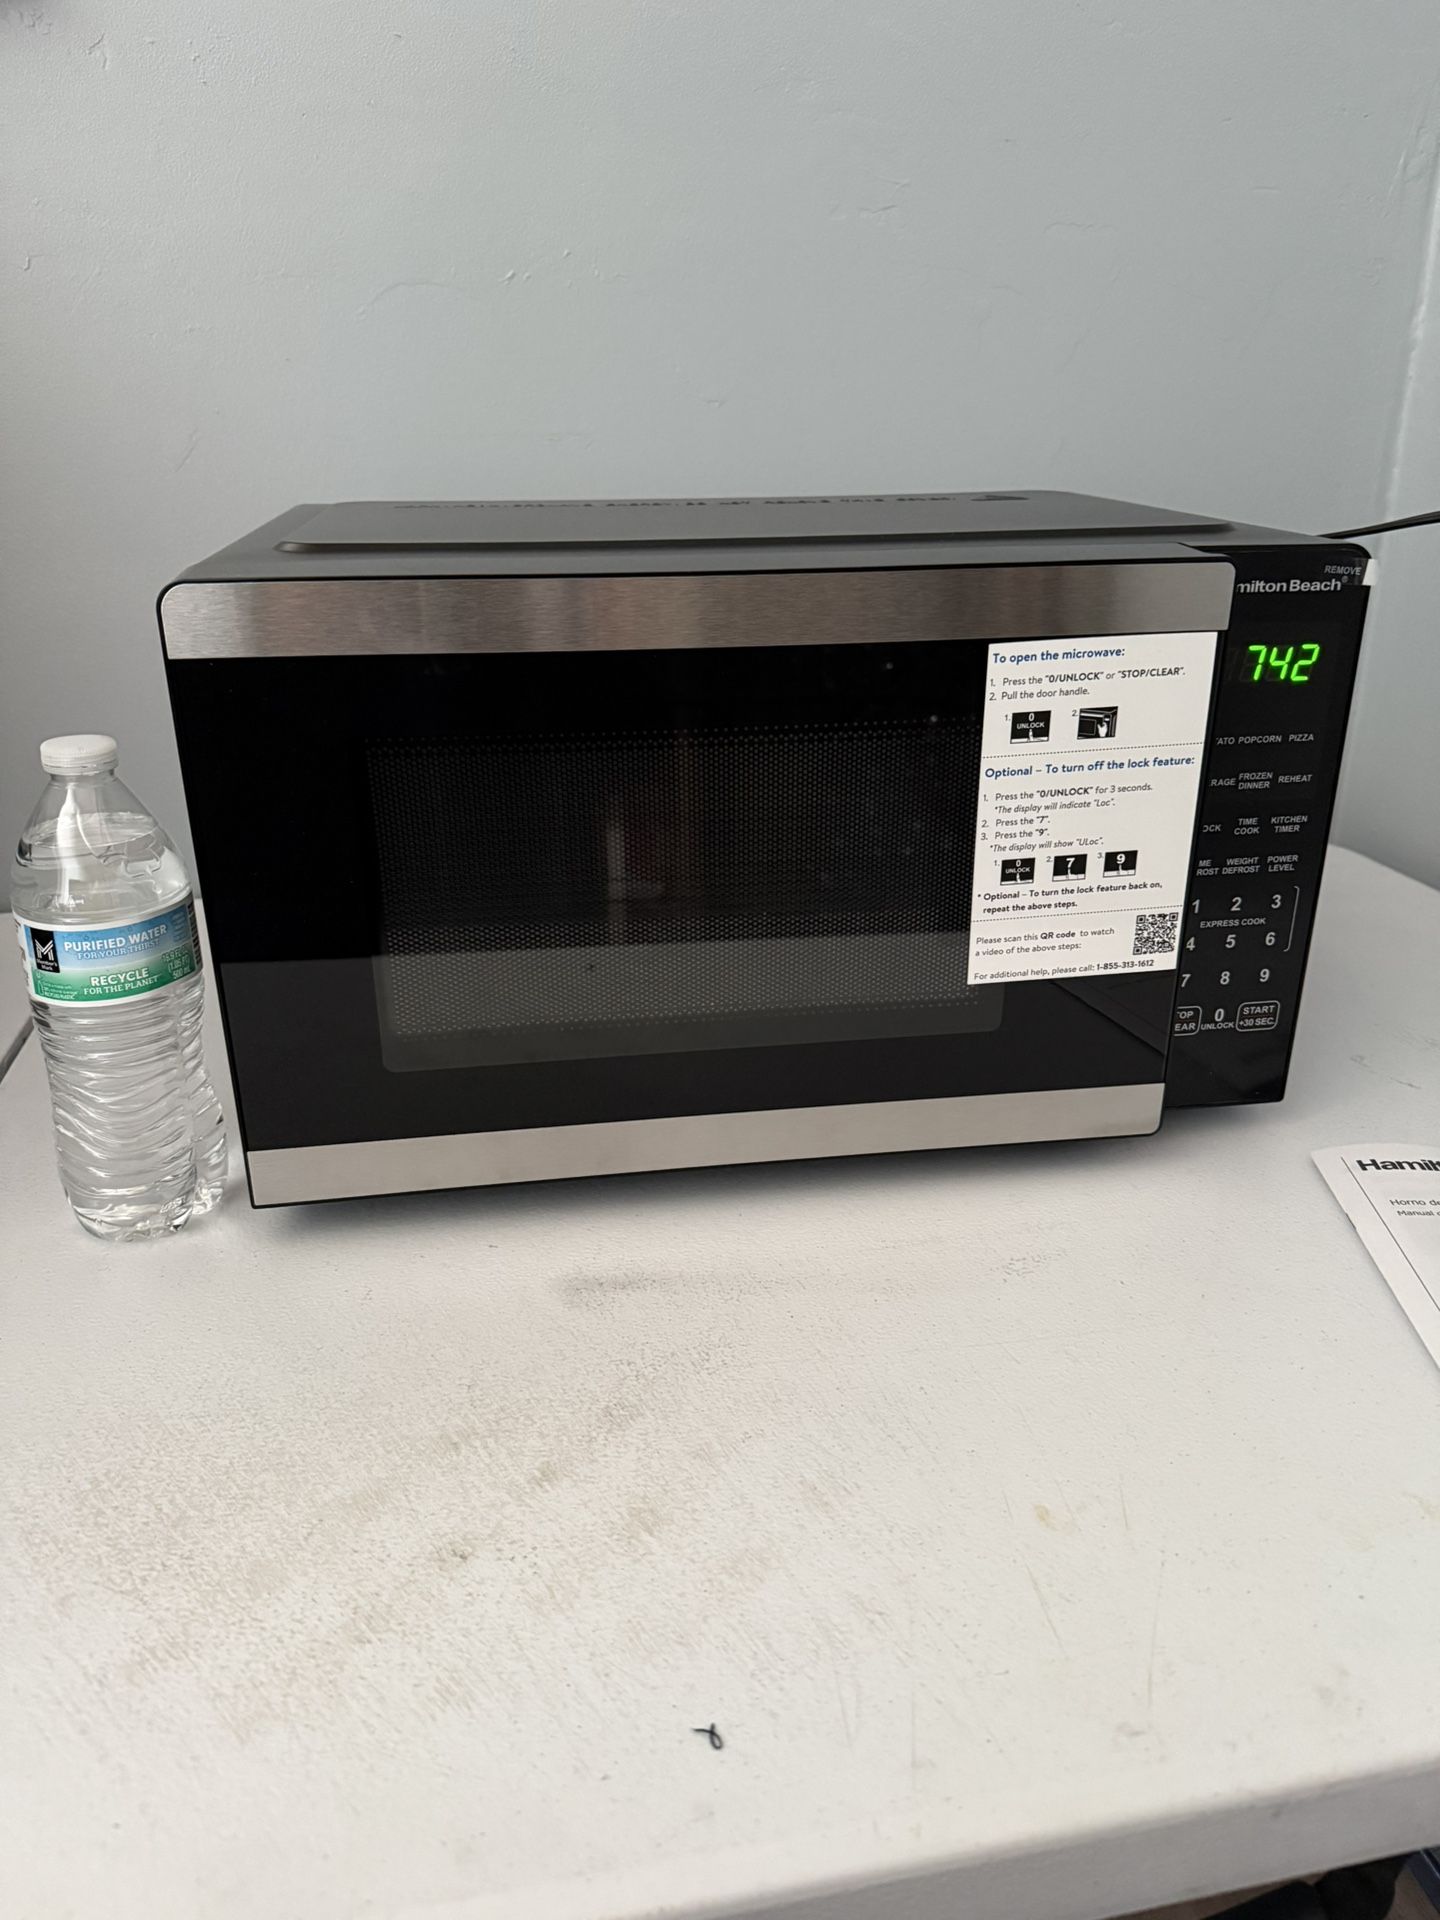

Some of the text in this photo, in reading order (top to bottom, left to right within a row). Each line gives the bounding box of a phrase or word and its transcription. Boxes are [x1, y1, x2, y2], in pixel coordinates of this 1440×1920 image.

[1324, 565, 1362, 575] REMOVE
[993, 648, 1125, 665] To open the microwave:
[990, 678, 996, 687] 1.
[1002, 677, 1026, 686] Press
[1028, 676, 1042, 685] the
[989, 687, 1090, 701] 2. Pull the door handle.
[1028, 713, 1034, 721] 0
[1216, 737, 1235, 745] ATO
[1238, 735, 1283, 744] POPCORN
[1288, 734, 1315, 742] PIZZA
[985, 765, 1033, 780] Optional
[1046, 764, 1058, 774] To
[1062, 763, 1084, 773] turn
[1087, 760, 1105, 771] off
[1107, 760, 1125, 770] the
[1127, 758, 1150, 769] lock
[1152, 757, 1195, 767] feature:
[1239, 772, 1273, 780] FROZEN
[1278, 774, 1312, 783] REHEAT
[1238, 781, 1270, 790] DINNER
[995, 792, 1018, 801] Press
[1020, 791, 1034, 800] the
[1095, 786, 1108, 794] for
[1110, 785, 1116, 793] 3
[1117, 783, 1153, 793] seconds.
[1014, 803, 1042, 814] display
[1044, 802, 1058, 810] will
[1060, 800, 1091, 810] indicate
[981, 820, 989, 828] 2.
[995, 819, 1018, 827] Press
[1020, 817, 1034, 826] the
[1271, 815, 1308, 824] KITCHEN
[1234, 827, 1260, 835] COOK
[1274, 825, 1300, 833] TIMER
[980, 832, 989, 841] 3.
[994, 831, 1017, 840] Press
[1019, 830, 1033, 838] the
[1008, 842, 1037, 853] display
[1038, 840, 1052, 849] will
[1053, 840, 1074, 848] show
[1066, 857, 1075, 868] 7
[1116, 853, 1126, 864] 9
[1226, 857, 1259, 866] WEIGHT
[1267, 855, 1299, 863] POWER
[1196, 868, 1219, 876] ROST
[1222, 865, 1260, 875] DEFROST
[1268, 864, 1295, 872] LEVEL
[983, 891, 1020, 902] Optional
[1029, 889, 1039, 897] To
[1061, 887, 1075, 895] the
[1076, 886, 1094, 894] lock
[1096, 884, 1127, 893] feature
[1128, 882, 1148, 890] back
[1192, 899, 1200, 914] 1
[1230, 897, 1242, 911] 2
[1271, 894, 1282, 909] 3
[983, 905, 1010, 915] repeat
[1054, 901, 1078, 910] steps.
[1200, 918, 1267, 928] EXPRESS COOK
[64, 937, 126, 952] PURIFIED
[128, 924, 167, 944] WATER
[976, 937, 1002, 945] Please
[1023, 933, 1038, 941] this
[1040, 931, 1054, 940] QR
[1055, 931, 1076, 939] code
[1091, 928, 1115, 936] watch
[1225, 934, 1236, 948] 5
[1265, 932, 1276, 946] 6
[78, 939, 160, 960] FOR YOUR THIRST
[1006, 946, 1016, 954] of
[1016, 946, 1030, 954] the
[1058, 943, 1081, 951] steps:
[1186, 937, 1195, 951] 4
[989, 969, 1029, 979] additional
[1030, 968, 1050, 976] help,
[1051, 967, 1077, 976] please
[1097, 959, 1155, 970] 1-855-313-1612
[90, 967, 149, 987] RECYCLE
[1220, 971, 1230, 985] 8
[1260, 968, 1270, 982] 9
[83, 987, 102, 995] FOR
[104, 984, 123, 993] THE
[125, 976, 159, 990] PLANET
[1181, 974, 1191, 988] 7
[1177, 1011, 1194, 1019] OP
[1214, 1008, 1224, 1022] 0
[1243, 1005, 1275, 1015] START
[1201, 1022, 1234, 1030] UNLOCK
